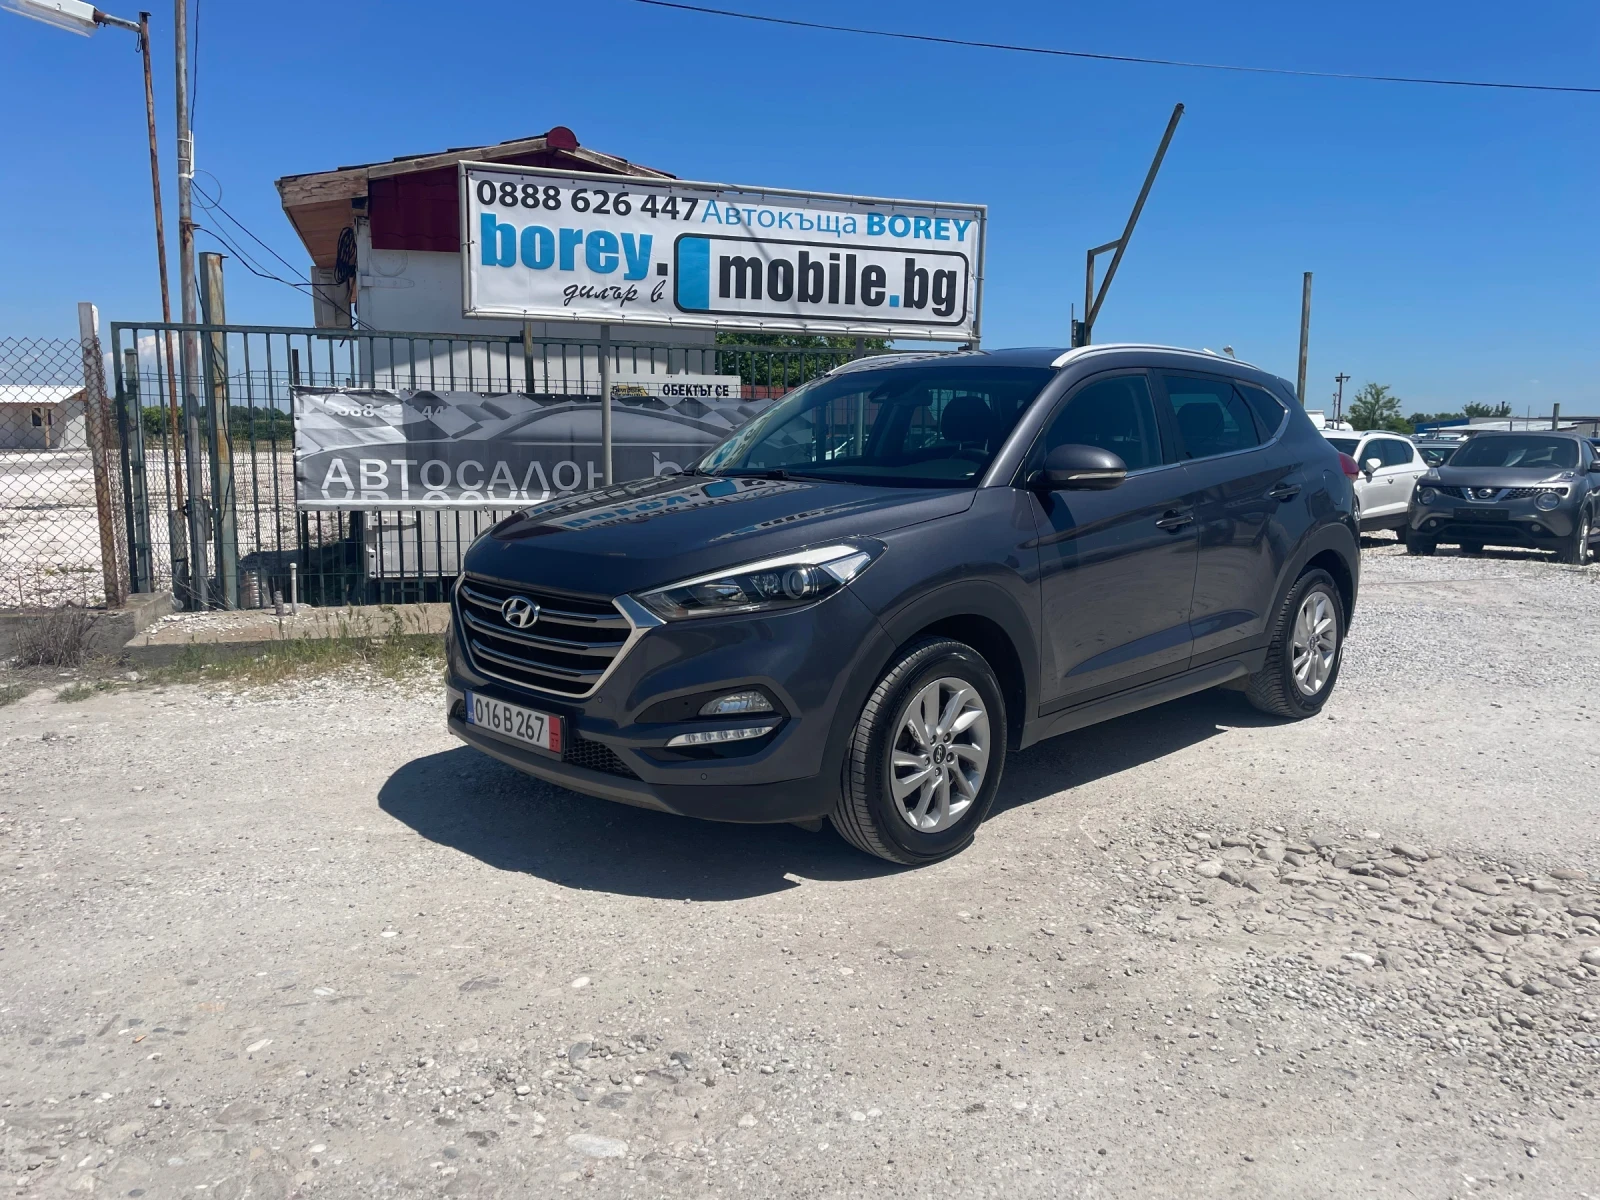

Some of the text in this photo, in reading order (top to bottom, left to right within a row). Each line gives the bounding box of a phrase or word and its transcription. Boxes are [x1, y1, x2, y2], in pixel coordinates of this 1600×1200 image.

[476, 179, 699, 221] 0888 626 447
[701, 199, 973, 242] Автокъща BOREY
[563, 283, 639, 307] дилър
[718, 250, 957, 317] mobile.bg
[662, 384, 713, 397] ОБЕКТЪТ
